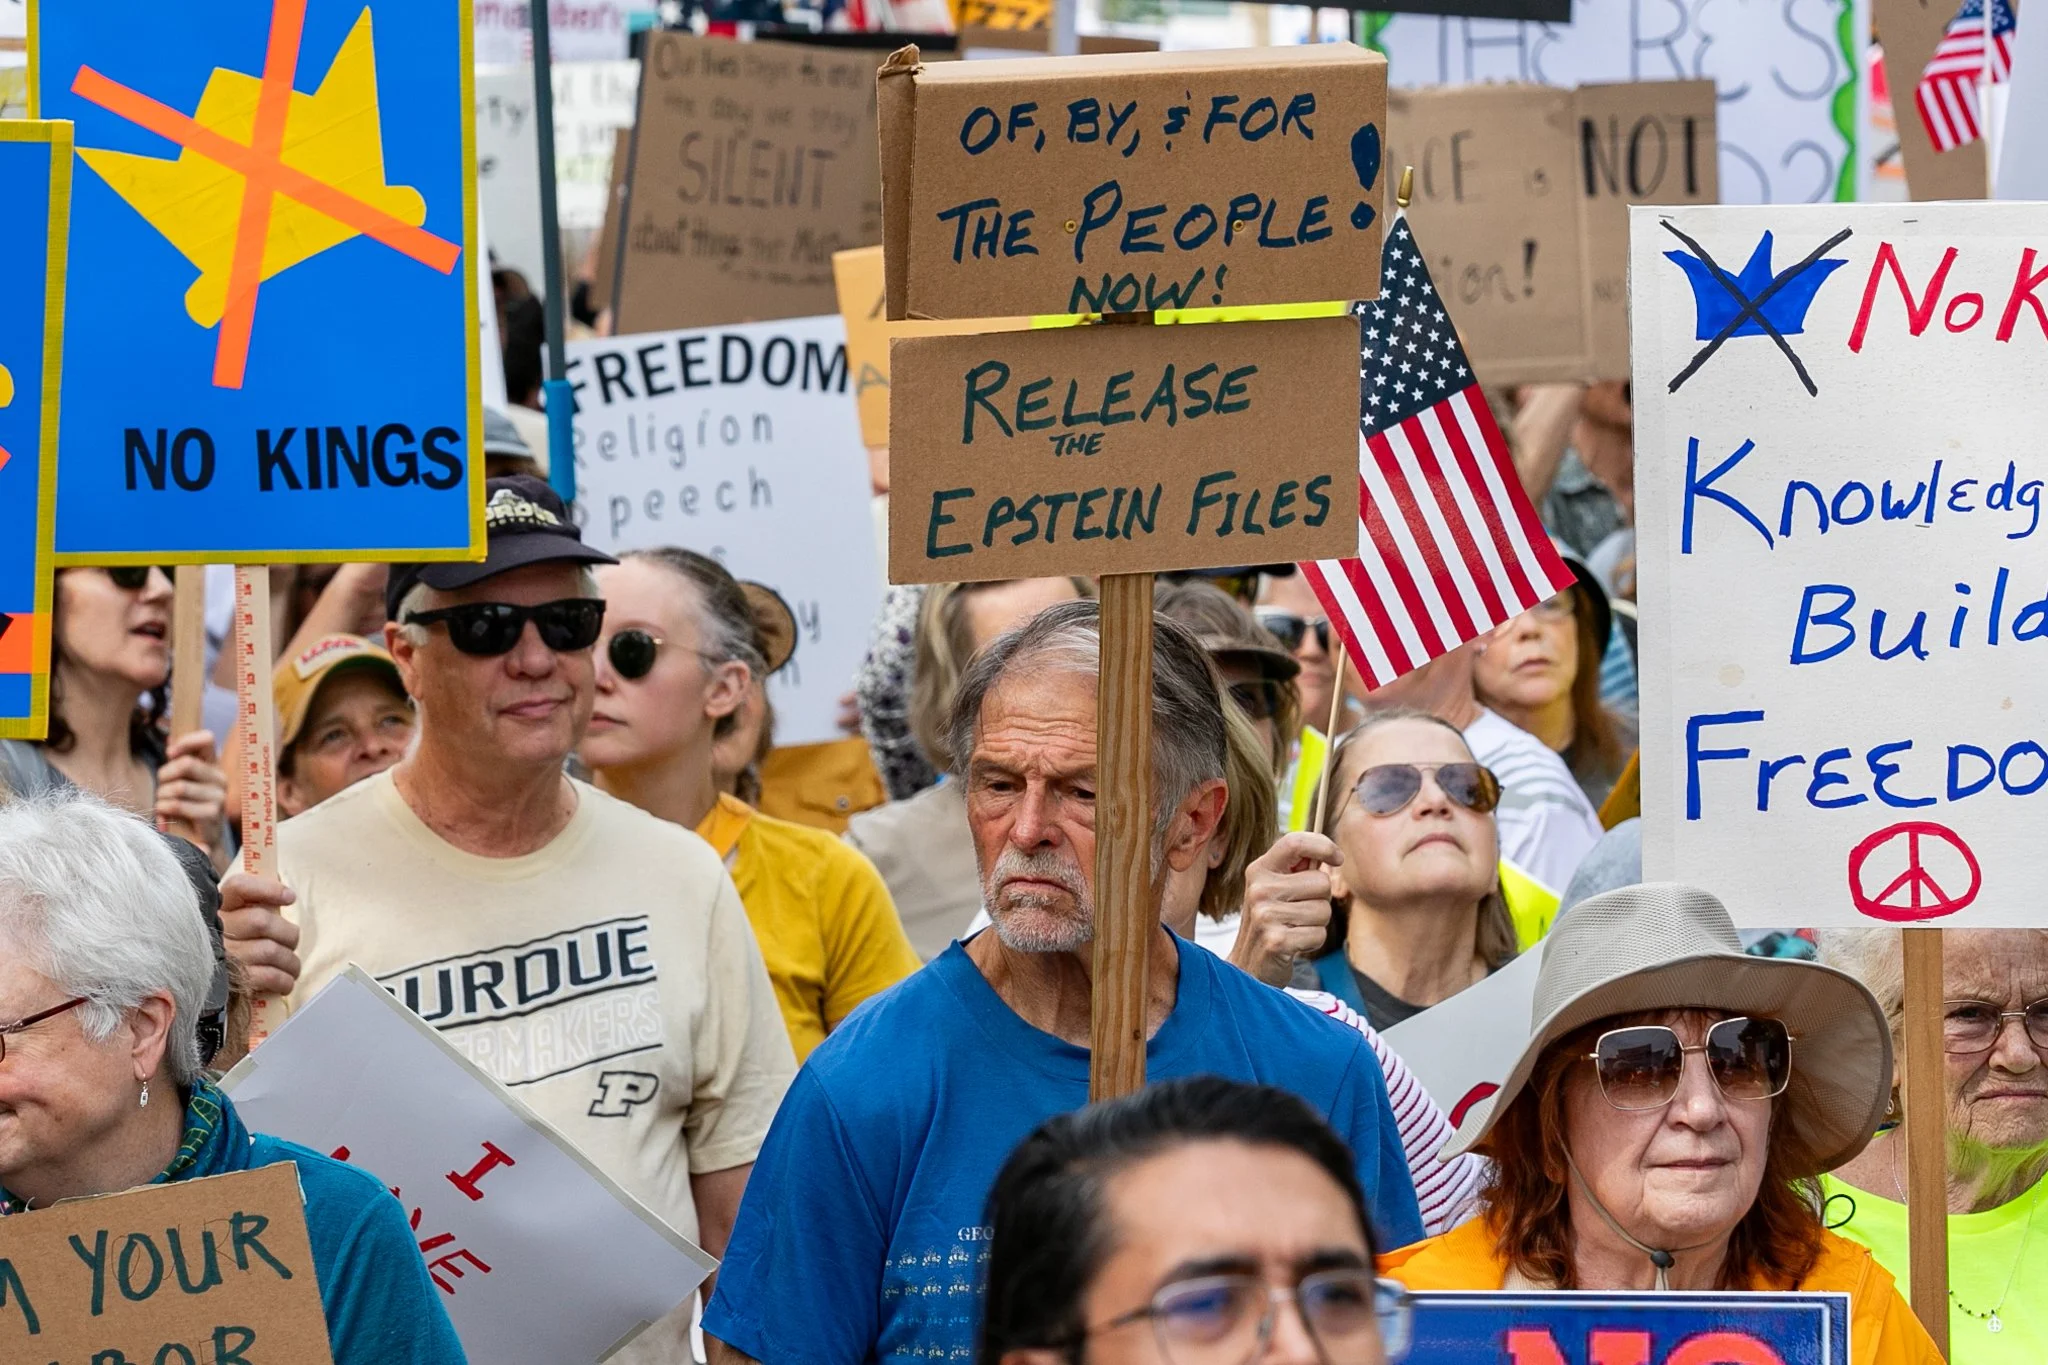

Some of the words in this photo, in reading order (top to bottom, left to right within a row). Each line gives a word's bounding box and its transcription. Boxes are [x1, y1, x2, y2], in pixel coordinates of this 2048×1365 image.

[960, 102, 1044, 154] OF,
[1067, 97, 1140, 157] BY,
[1203, 93, 1317, 142] FOR
[1579, 113, 1714, 198] NOT
[678, 131, 836, 210] SILENT
[937, 198, 1040, 264] THE
[1069, 264, 1228, 314] NOW!
[963, 361, 1259, 445] RELEASE
[124, 427, 216, 492] NO
[256, 422, 464, 492] KINGS
[1050, 432, 1105, 456] THE
[926, 485, 1162, 559] EPSTEIN
[1186, 471, 1332, 536] FILES
[262, 742, 273, 779] place.
[263, 781, 273, 821] helpful
[264, 822, 273, 848] The
[385, 924, 656, 1022] URDUE
[446, 1141, 516, 1201] I
[67, 1210, 294, 1317] YOUR
